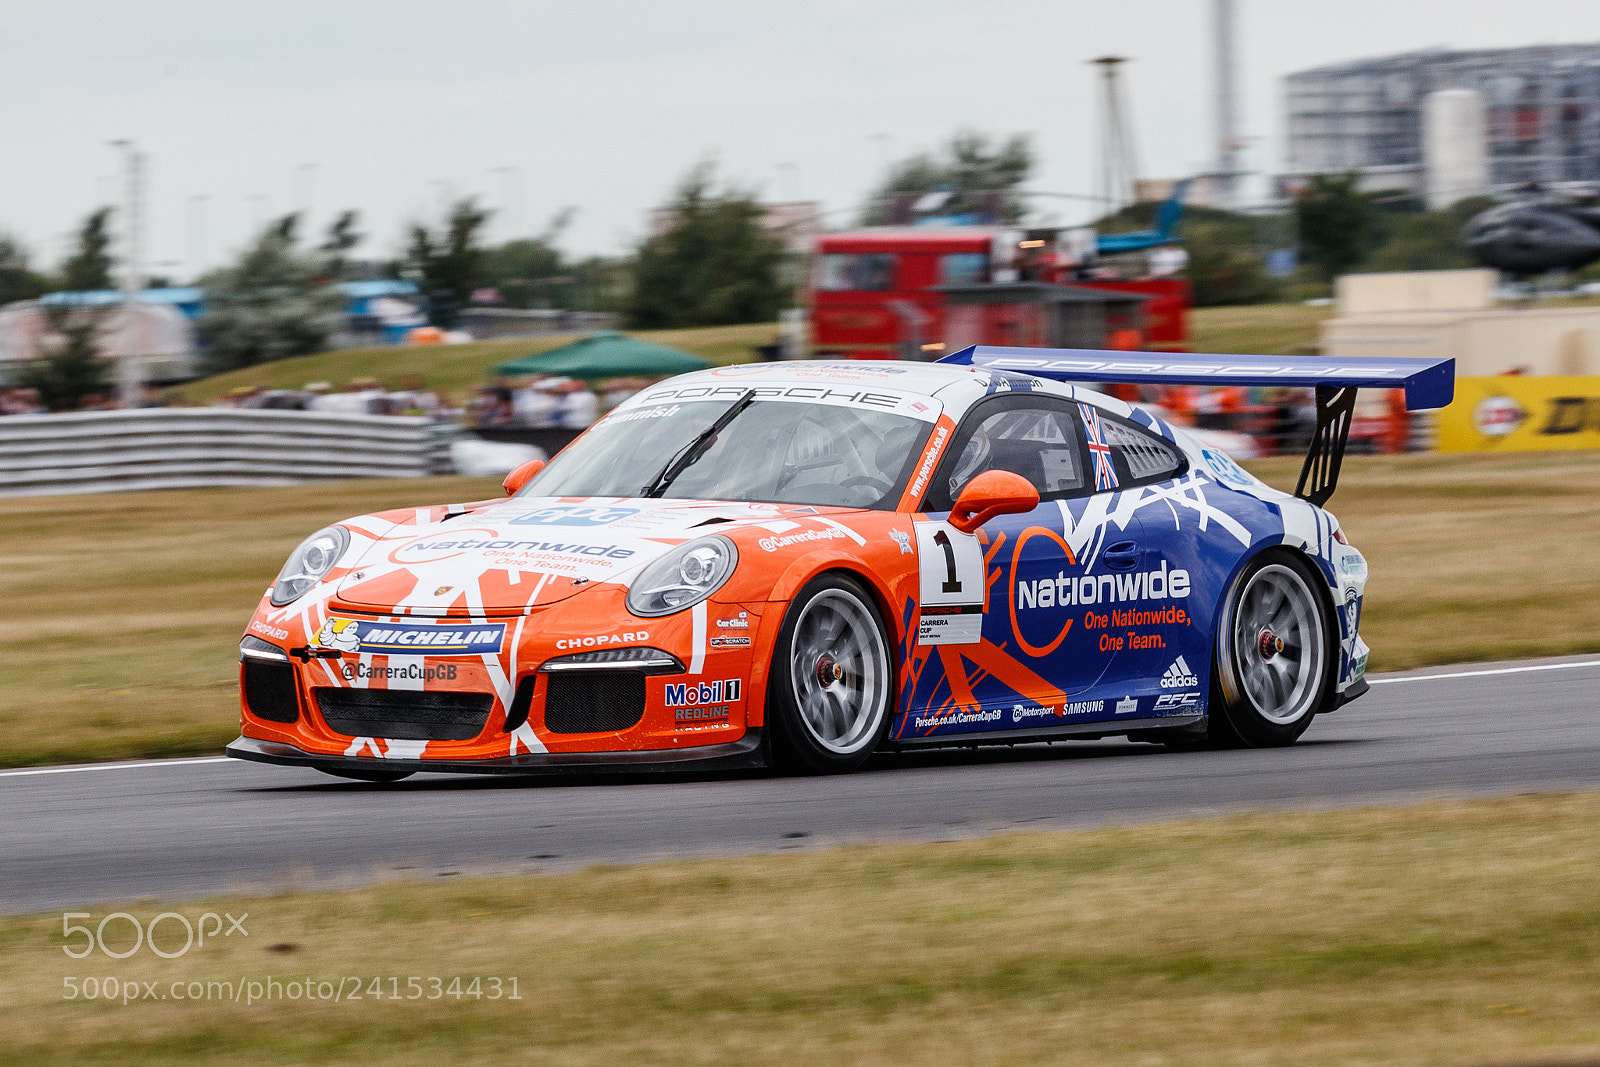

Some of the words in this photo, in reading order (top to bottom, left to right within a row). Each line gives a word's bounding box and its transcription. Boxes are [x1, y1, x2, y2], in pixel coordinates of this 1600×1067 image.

[983, 358, 1395, 377] PORSCHE
[641, 387, 901, 408] PORSCHE
[910, 426, 948, 497] www.porsche.co.uk
[404, 539, 636, 559] Nationwide
[758, 527, 846, 552] @CarreraCupGB
[482, 549, 515, 557] One
[933, 530, 962, 593] 1
[494, 558, 526, 567] One
[530, 560, 578, 572] Team.
[1018, 559, 1191, 610] Nationwide
[920, 619, 949, 627] CARRERA
[1084, 611, 1109, 629] One
[1111, 605, 1192, 628] Nationwide,
[250, 620, 289, 640] CHOPARD
[362, 628, 500, 645] MICHELIN
[556, 630, 650, 650] CHOPARD
[1099, 633, 1124, 651] One
[1127, 632, 1167, 650] Team.
[341, 662, 457, 682] @CarreraCupGB
[1160, 675, 1198, 688] adidas
[665, 681, 723, 706] Mobil
[1156, 692, 1200, 706] PFC
[675, 705, 730, 720] REDLINE
[1063, 700, 1104, 715] SAMSUNG
[675, 722, 730, 732] RACING
[915, 709, 1002, 728] Porsche.co.uk/CarreraCupGB
